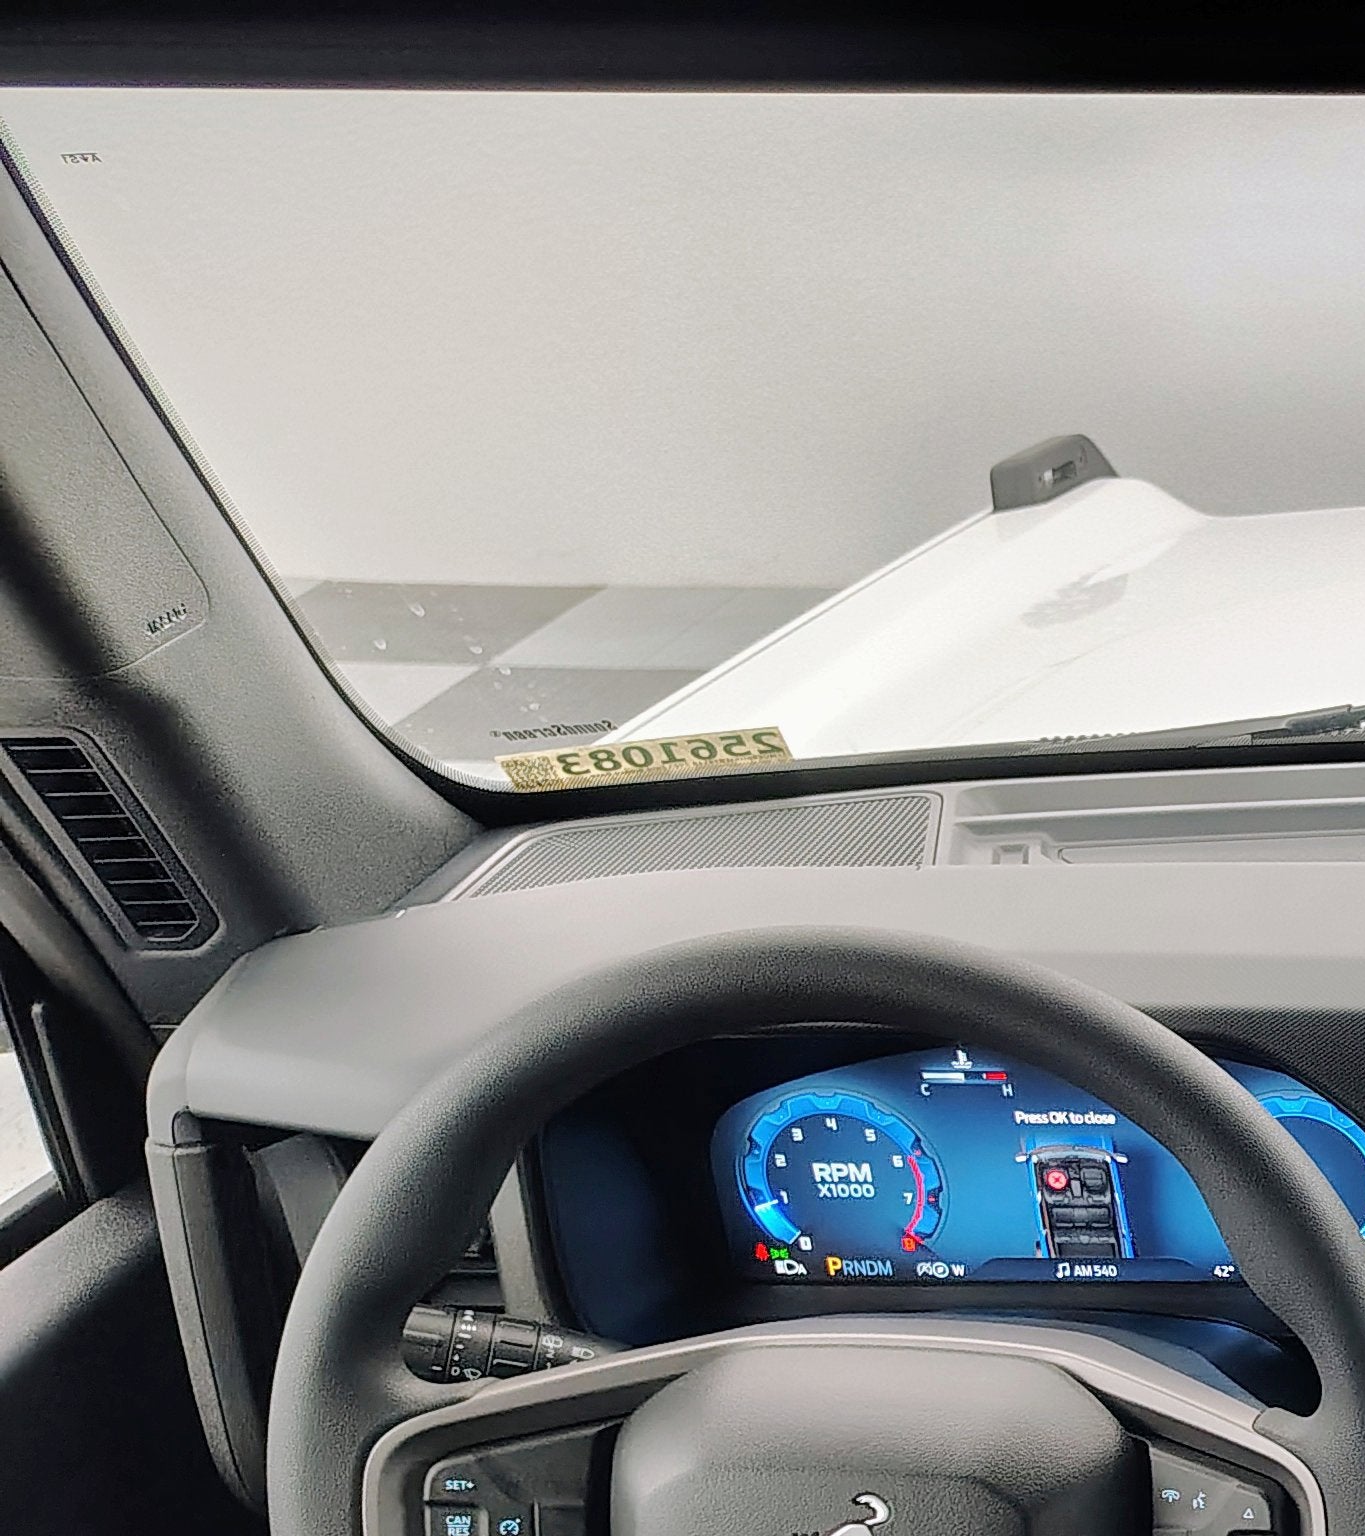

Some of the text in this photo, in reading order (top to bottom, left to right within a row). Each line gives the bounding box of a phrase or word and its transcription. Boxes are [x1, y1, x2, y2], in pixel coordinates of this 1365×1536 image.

[920, 1082, 932, 1096] C
[1002, 1082, 1014, 1097] H
[825, 1118, 838, 1131] 4
[1014, 1111, 1116, 1125] Press OK to close
[791, 1127, 805, 1142] 3
[864, 1128, 877, 1142] 5
[774, 1153, 788, 1168] 2
[892, 1154, 904, 1168] 6
[811, 1162, 873, 1183] RPM
[816, 1184, 875, 1198] X1000
[903, 1192, 914, 1205] 7
[798, 1236, 813, 1251] 0
[825, 1255, 893, 1277] PRNDM
[1073, 1265, 1118, 1277] AM 540
[445, 1515, 472, 1525] CAN
[447, 1527, 470, 1536] RES
